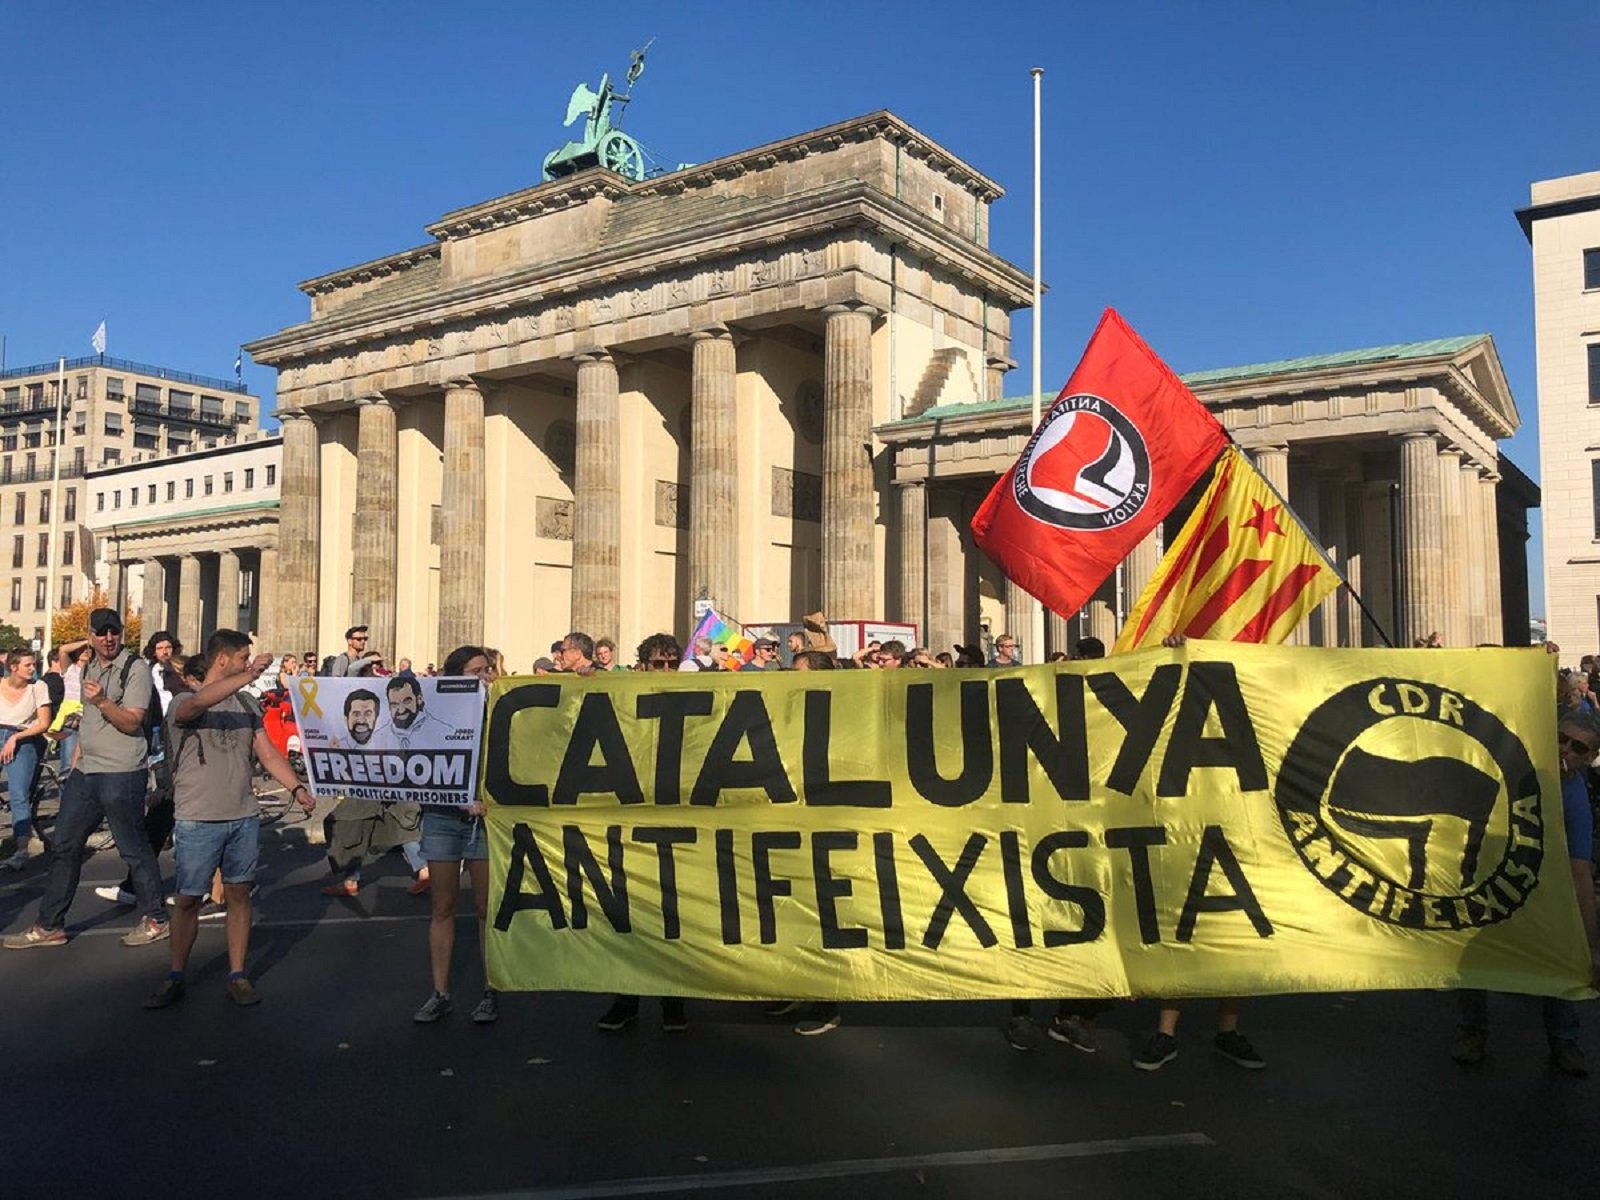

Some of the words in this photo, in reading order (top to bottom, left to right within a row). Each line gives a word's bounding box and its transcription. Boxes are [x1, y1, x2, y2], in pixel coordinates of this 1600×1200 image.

[485, 661, 1269, 808] CATALUNYA
[1367, 682, 1464, 727] CDR
[312, 751, 466, 786] FREEDOM
[349, 787, 402, 801] POLITICAL
[405, 790, 468, 804] PRISONERS
[493, 823, 1275, 950] ANTIFEIXISTA
[1286, 794, 1541, 928] ANTIFEIXISTA
